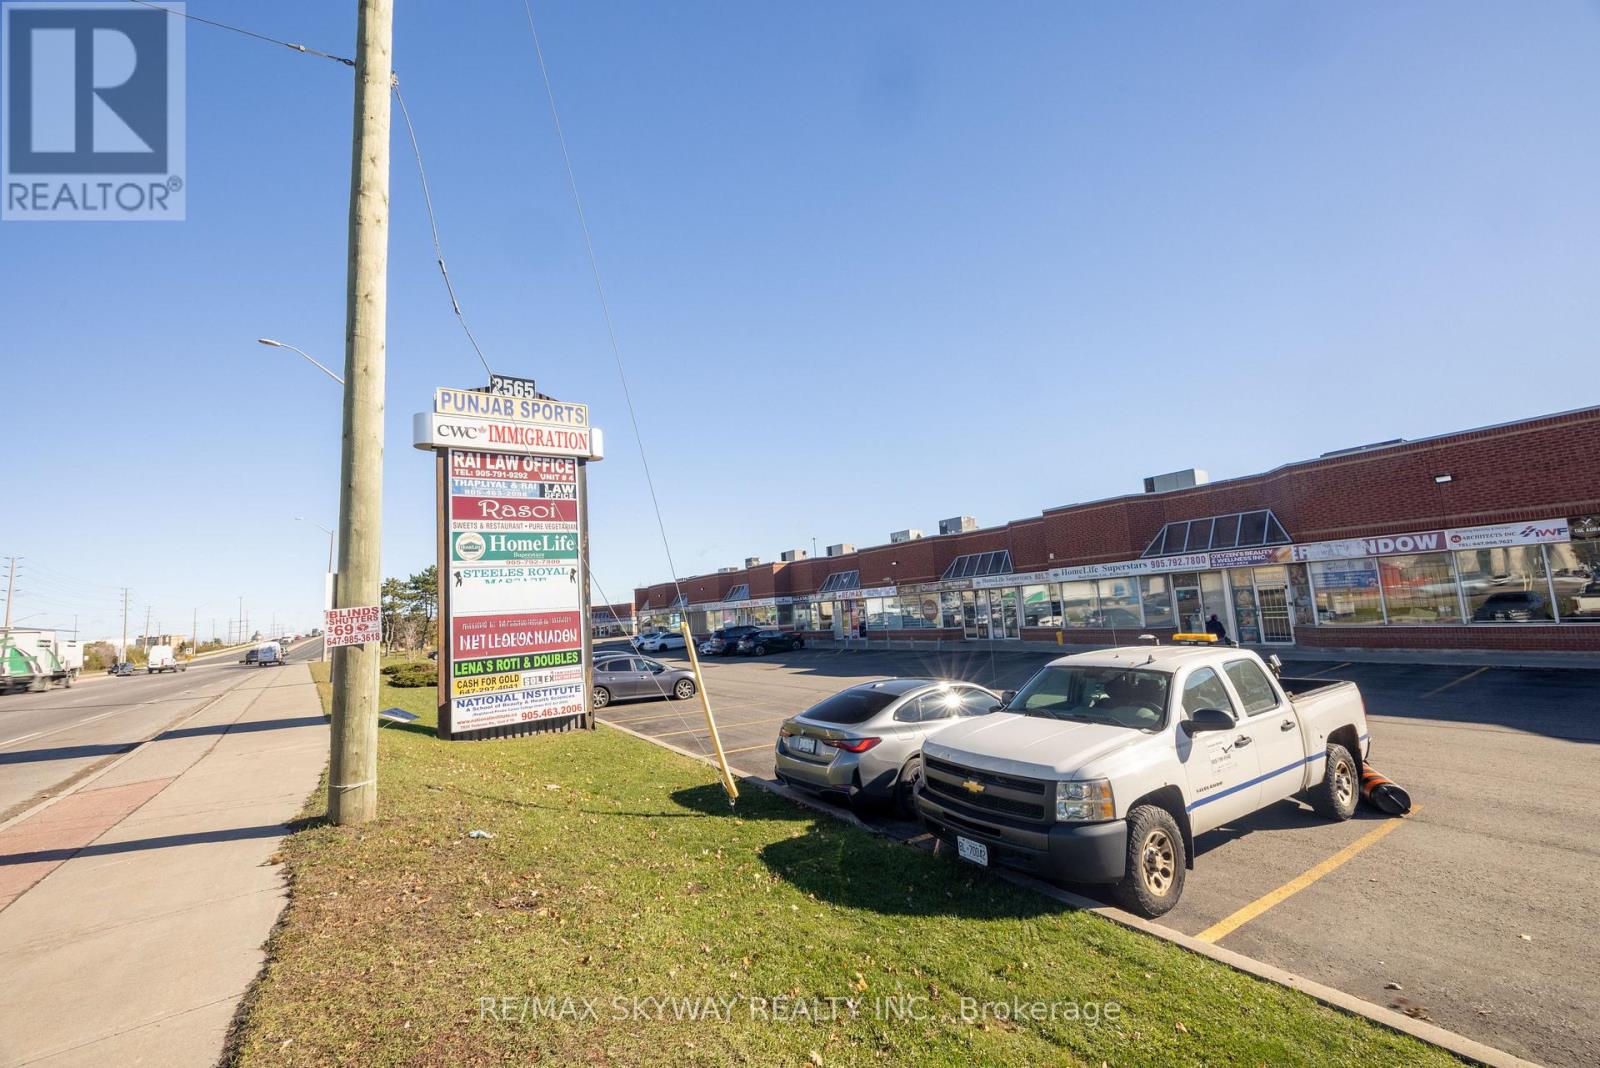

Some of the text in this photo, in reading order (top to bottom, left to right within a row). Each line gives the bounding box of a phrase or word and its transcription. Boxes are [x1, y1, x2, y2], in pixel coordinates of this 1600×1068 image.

[492, 378, 535, 399] 2565
[441, 391, 584, 424] PUNJAB SPORTS
[437, 424, 588, 450] CWC IMMIGRATION
[453, 452, 574, 474] RAI LAW OFFICE
[454, 480, 506, 489] THAPLIYAL
[544, 483, 575, 493] LAW
[478, 500, 556, 519] Rasoi
[452, 522, 478, 530] SWEETS
[486, 522, 525, 530] RESTAURANT
[544, 523, 576, 531] VEGETARIAN
[490, 534, 575, 552] HomeLife
[1462, 532, 1501, 541] ARCHITECTS
[1244, 548, 1273, 557] BEAUTY
[463, 567, 569, 579] STEELES ROYAL
[1061, 566, 1099, 576] HomeLife
[1102, 562, 1148, 573] Superstars
[1150, 555, 1206, 569] 905.792.7800
[328, 614, 379, 626] SHUTTERS
[329, 607, 380, 619] BLINDS
[496, 657, 520, 673] ROTI
[523, 656, 531, 669] &
[533, 651, 579, 667] DOUBLES
[456, 674, 520, 690] CASH FOR GOLD
[456, 692, 519, 708] NATIONAL
[522, 684, 581, 700] INSTITUTE
[521, 704, 583, 721] 905.463.2006
